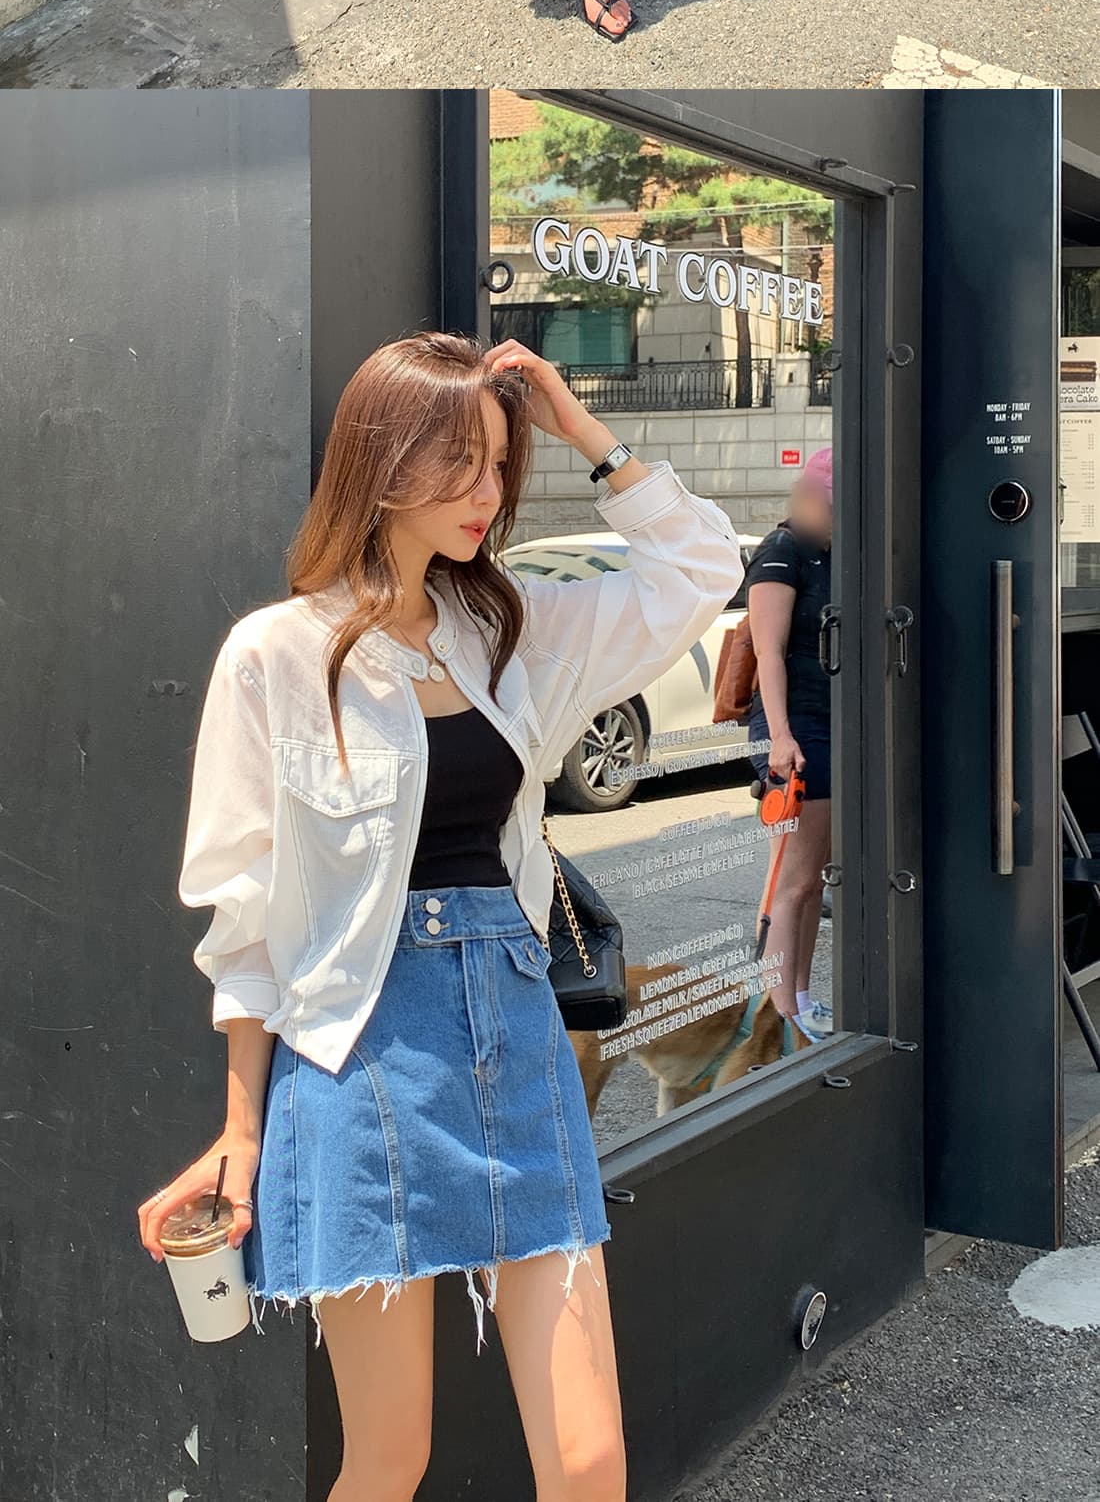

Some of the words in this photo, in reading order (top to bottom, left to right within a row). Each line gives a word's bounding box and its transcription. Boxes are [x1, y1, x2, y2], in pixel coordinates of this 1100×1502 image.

[531, 217, 668, 294] GOAT
[677, 252, 824, 326] COFFEE
[1061, 384, 1095, 394] ocolate
[1012, 402, 1030, 411] FRIDAY
[1010, 435, 1031, 444] SUNDAY
[633, 877, 666, 898] BLACK
[666, 865, 704, 888] SESAME
[640, 975, 678, 1001] LEMON
[677, 965, 703, 987] EARL
[702, 956, 727, 977] GREY
[725, 961, 762, 988] POTATO
[600, 1033, 636, 1060] FRESH
[635, 1011, 688, 1046] SQUEEZED
